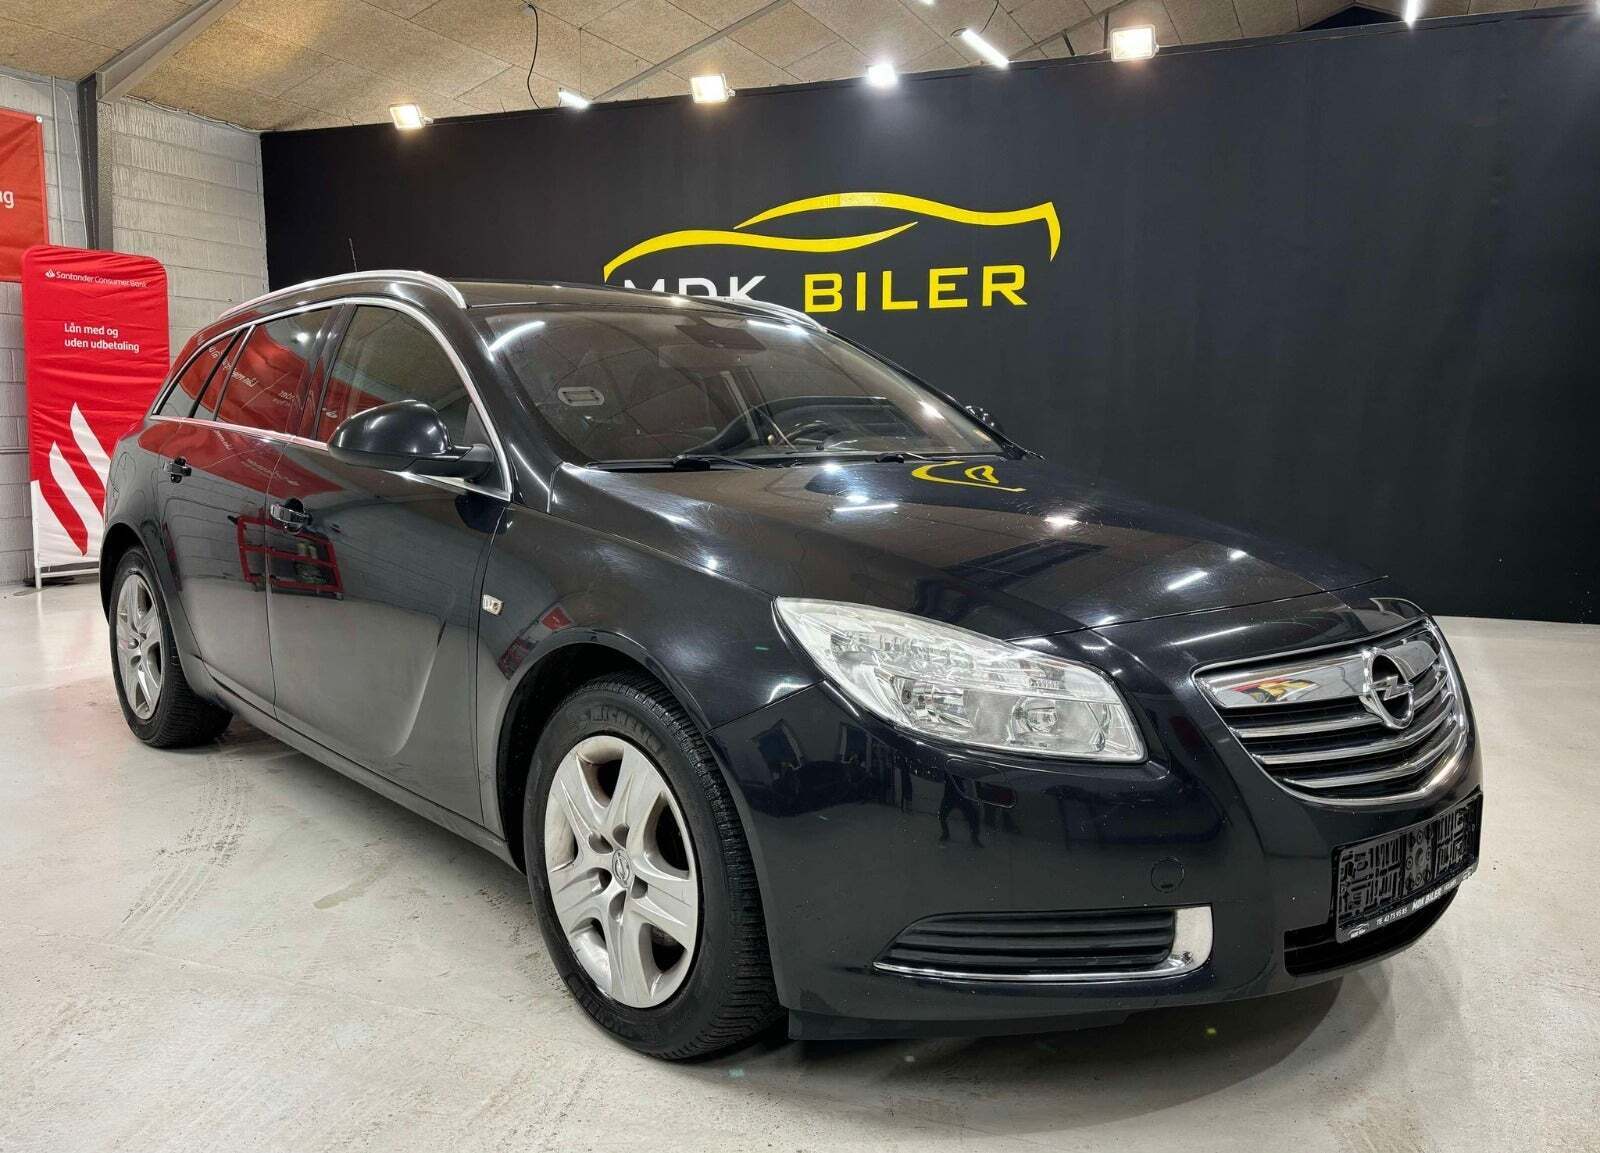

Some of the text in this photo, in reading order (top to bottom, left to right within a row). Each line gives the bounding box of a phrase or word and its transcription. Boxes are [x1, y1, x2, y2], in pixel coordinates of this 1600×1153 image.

[56, 271, 94, 283] Santander
[95, 276, 129, 286] Consumer
[804, 264, 1027, 313] BILER
[64, 322, 118, 338] Lån med og
[64, 338, 139, 353] uden udbetaling
